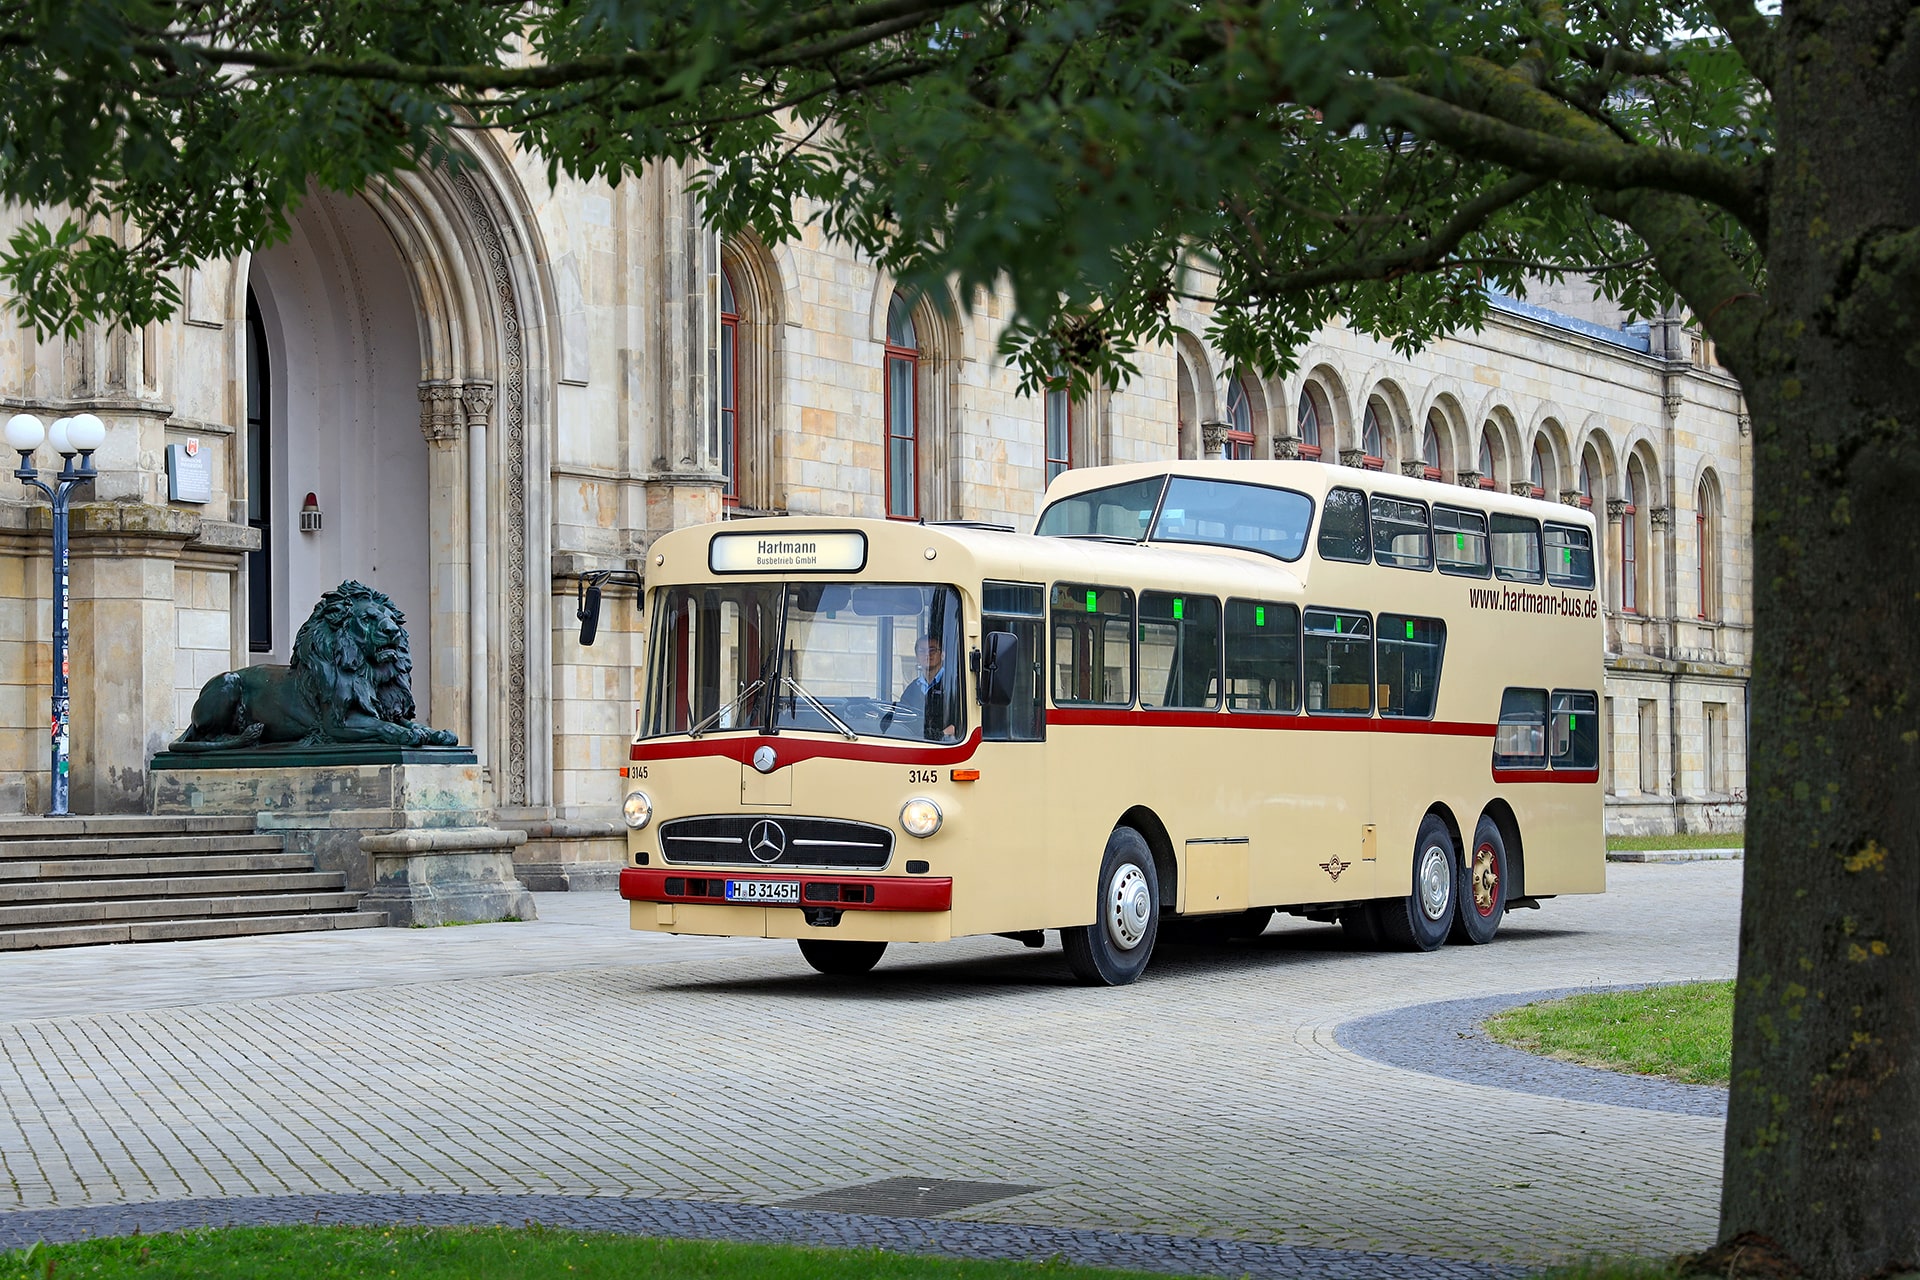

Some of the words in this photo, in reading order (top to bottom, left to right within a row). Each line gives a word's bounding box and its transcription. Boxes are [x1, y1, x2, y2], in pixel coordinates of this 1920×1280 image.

[758, 540, 816, 554] Hartmann
[757, 556, 794, 565] Busbetrieb
[795, 556, 817, 565] GmbH
[1469, 585, 1597, 619] www.hartmann-bus.de
[631, 766, 648, 779] 3145
[909, 769, 938, 783] 3145
[733, 883, 741, 897] H
[748, 883, 757, 897] B
[758, 883, 799, 898] 3145H
